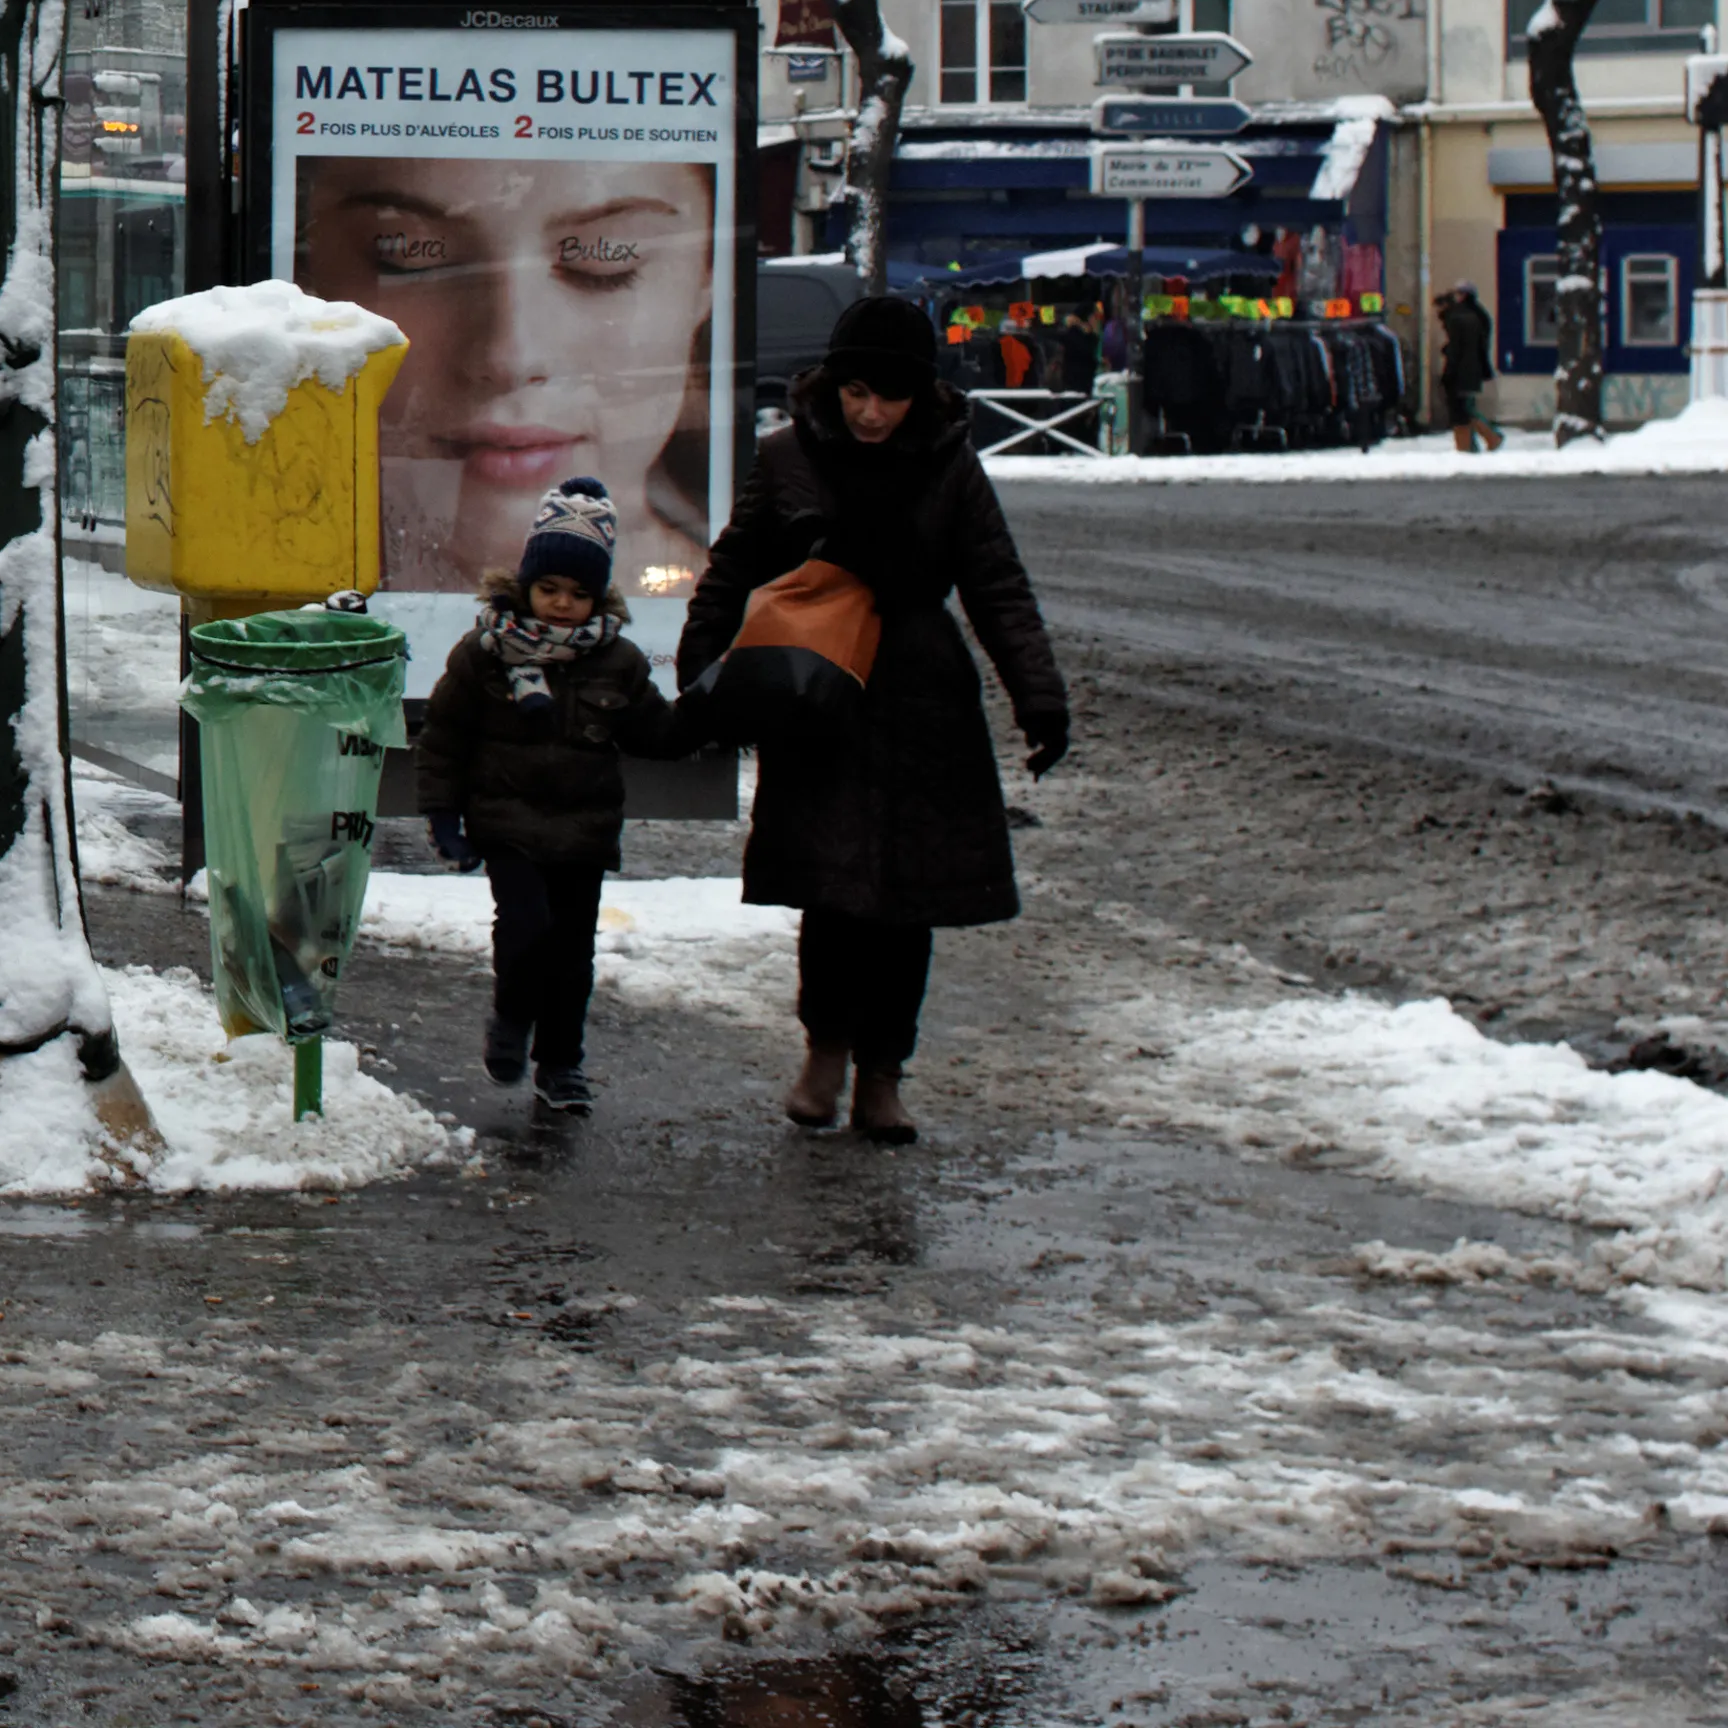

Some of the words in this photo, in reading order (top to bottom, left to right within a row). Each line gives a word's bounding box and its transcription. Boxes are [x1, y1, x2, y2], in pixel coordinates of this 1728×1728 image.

[460, 11, 559, 29] JCDecaux
[1149, 46, 1218, 60] BAGNOLET
[296, 65, 517, 102] MATELAS
[537, 69, 717, 106] BULTEX
[296, 112, 315, 135] 2
[321, 123, 356, 136] FOIS
[361, 124, 401, 137] PLUS
[405, 122, 500, 139] D'ALVÉOLES
[514, 115, 533, 138] 2
[538, 126, 574, 140] FOIS
[578, 127, 619, 141] PLUS
[624, 128, 644, 141] DE
[649, 128, 718, 142] SOUTIEN
[1109, 176, 1202, 189] Commissariat
[374, 232, 447, 260] Merci
[558, 235, 640, 263] Bultex
